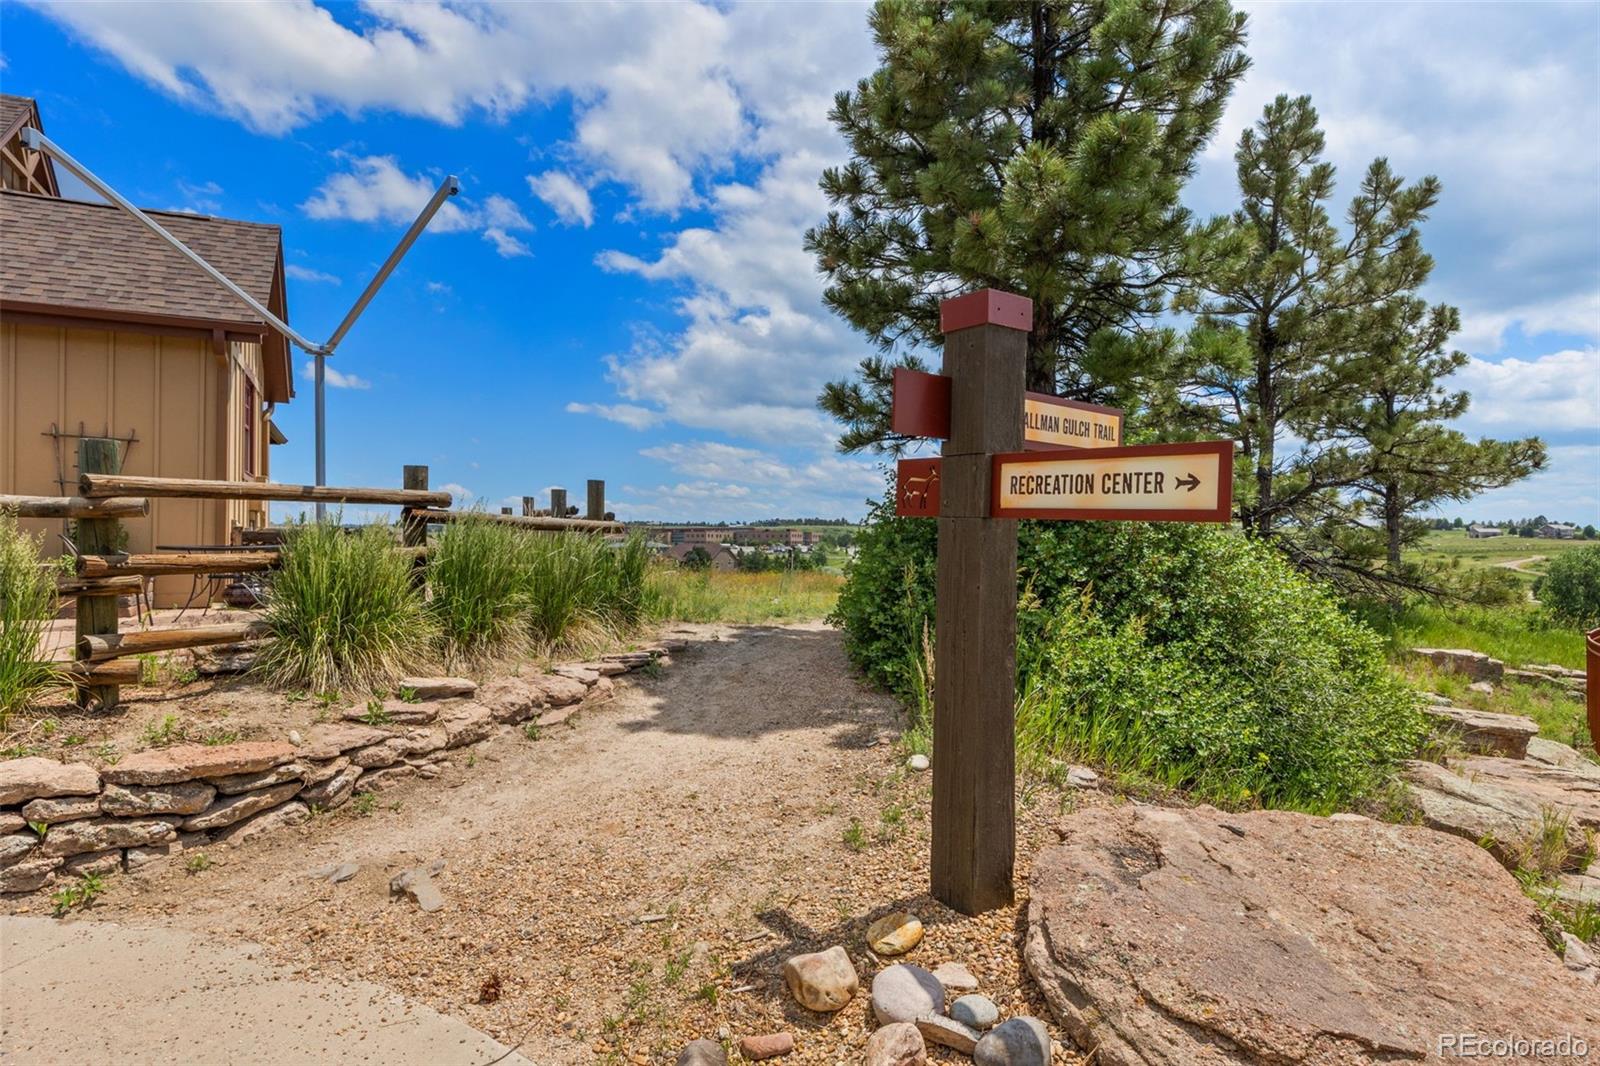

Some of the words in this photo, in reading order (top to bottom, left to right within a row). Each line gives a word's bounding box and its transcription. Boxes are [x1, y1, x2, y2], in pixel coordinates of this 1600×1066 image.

[1062, 417, 1091, 438] GULCH
[1094, 422, 1116, 442] TRAIL
[1009, 473, 1095, 496] RECREATION
[1101, 471, 1165, 495] CENTER
